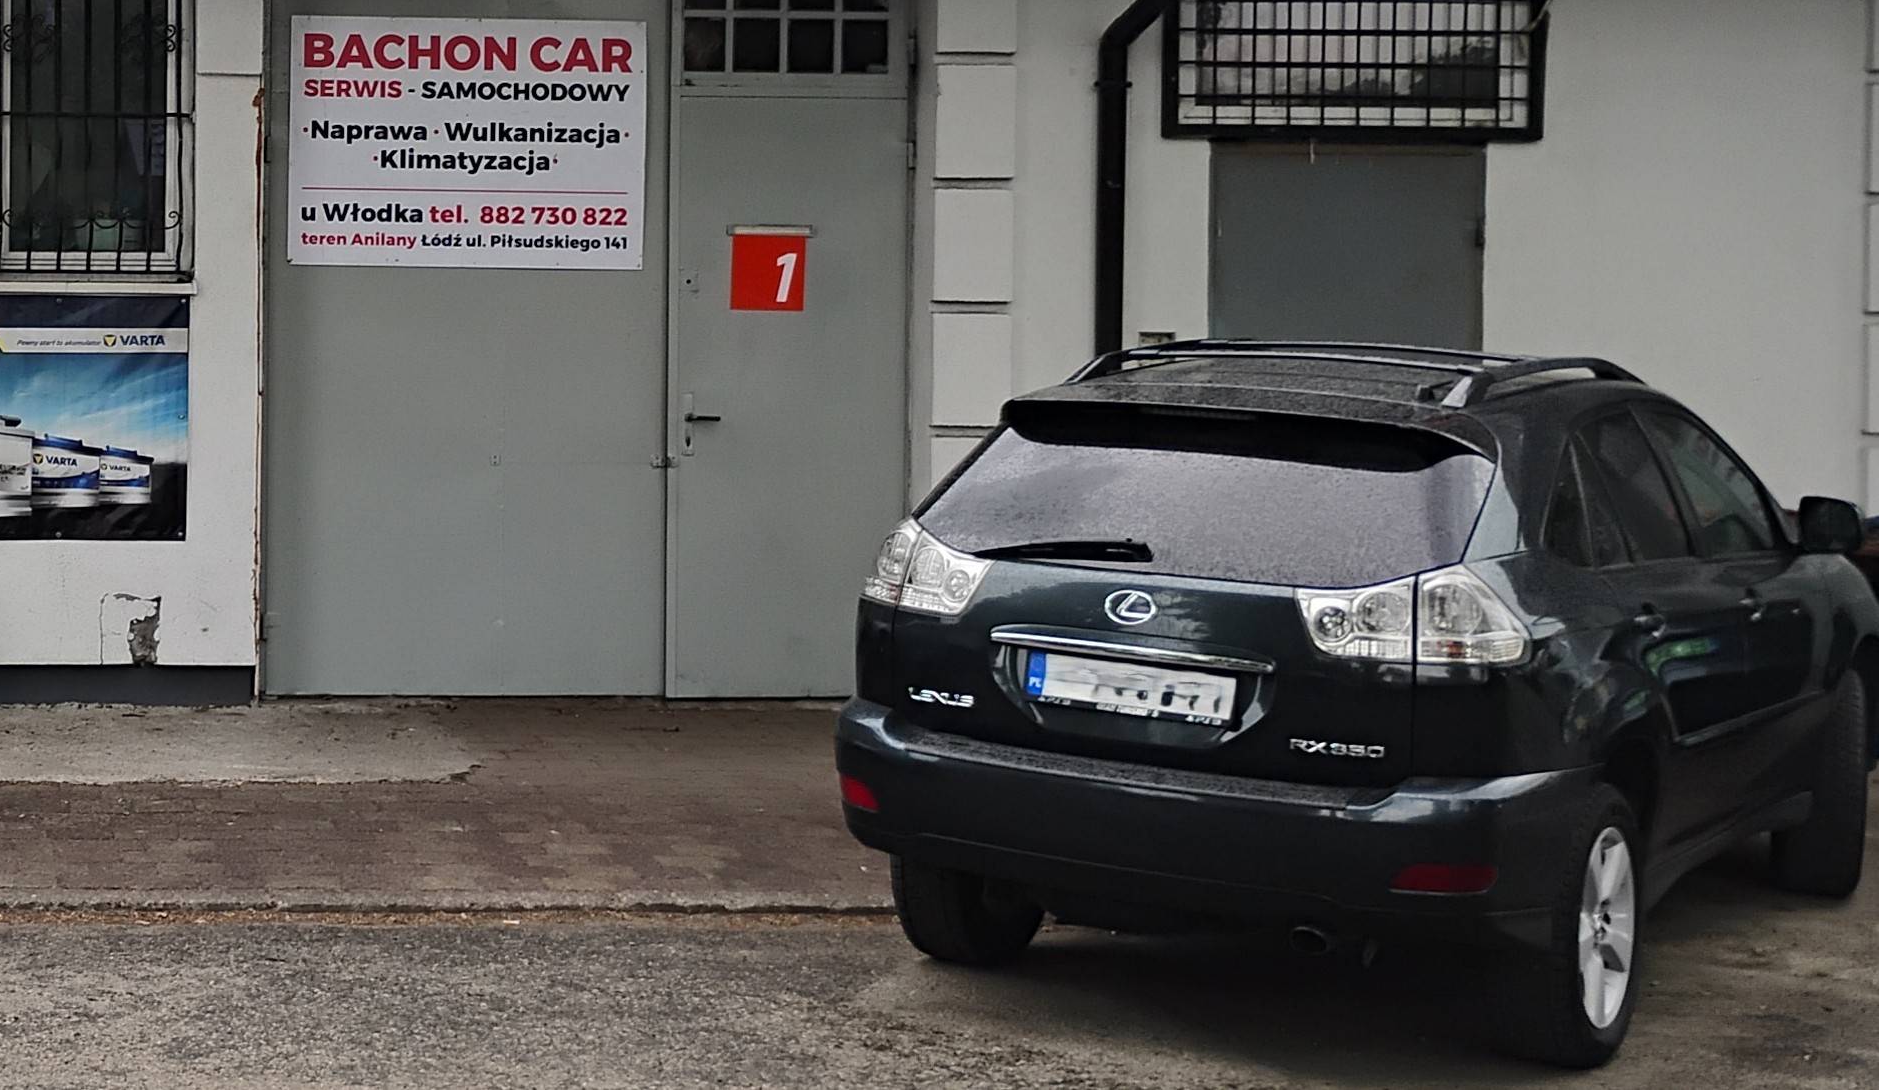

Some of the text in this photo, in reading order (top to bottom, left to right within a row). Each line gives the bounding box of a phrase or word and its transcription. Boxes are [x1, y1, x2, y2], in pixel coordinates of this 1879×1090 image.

[303, 33, 633, 73] BACHON CAR
[303, 79, 402, 98] SERWIS
[421, 81, 630, 102] SAMOCHODOWY
[300, 203, 628, 226] u Włodka tel. 882 730 822
[301, 232, 628, 252] teren Anilany Łódź ul. Piłsudskiego 141
[776, 253, 797, 302] 1
[120, 334, 166, 346] VARTA
[46, 456, 78, 466] VARTA
[109, 464, 131, 472] VARTA
[908, 687, 974, 707] LEXUS
